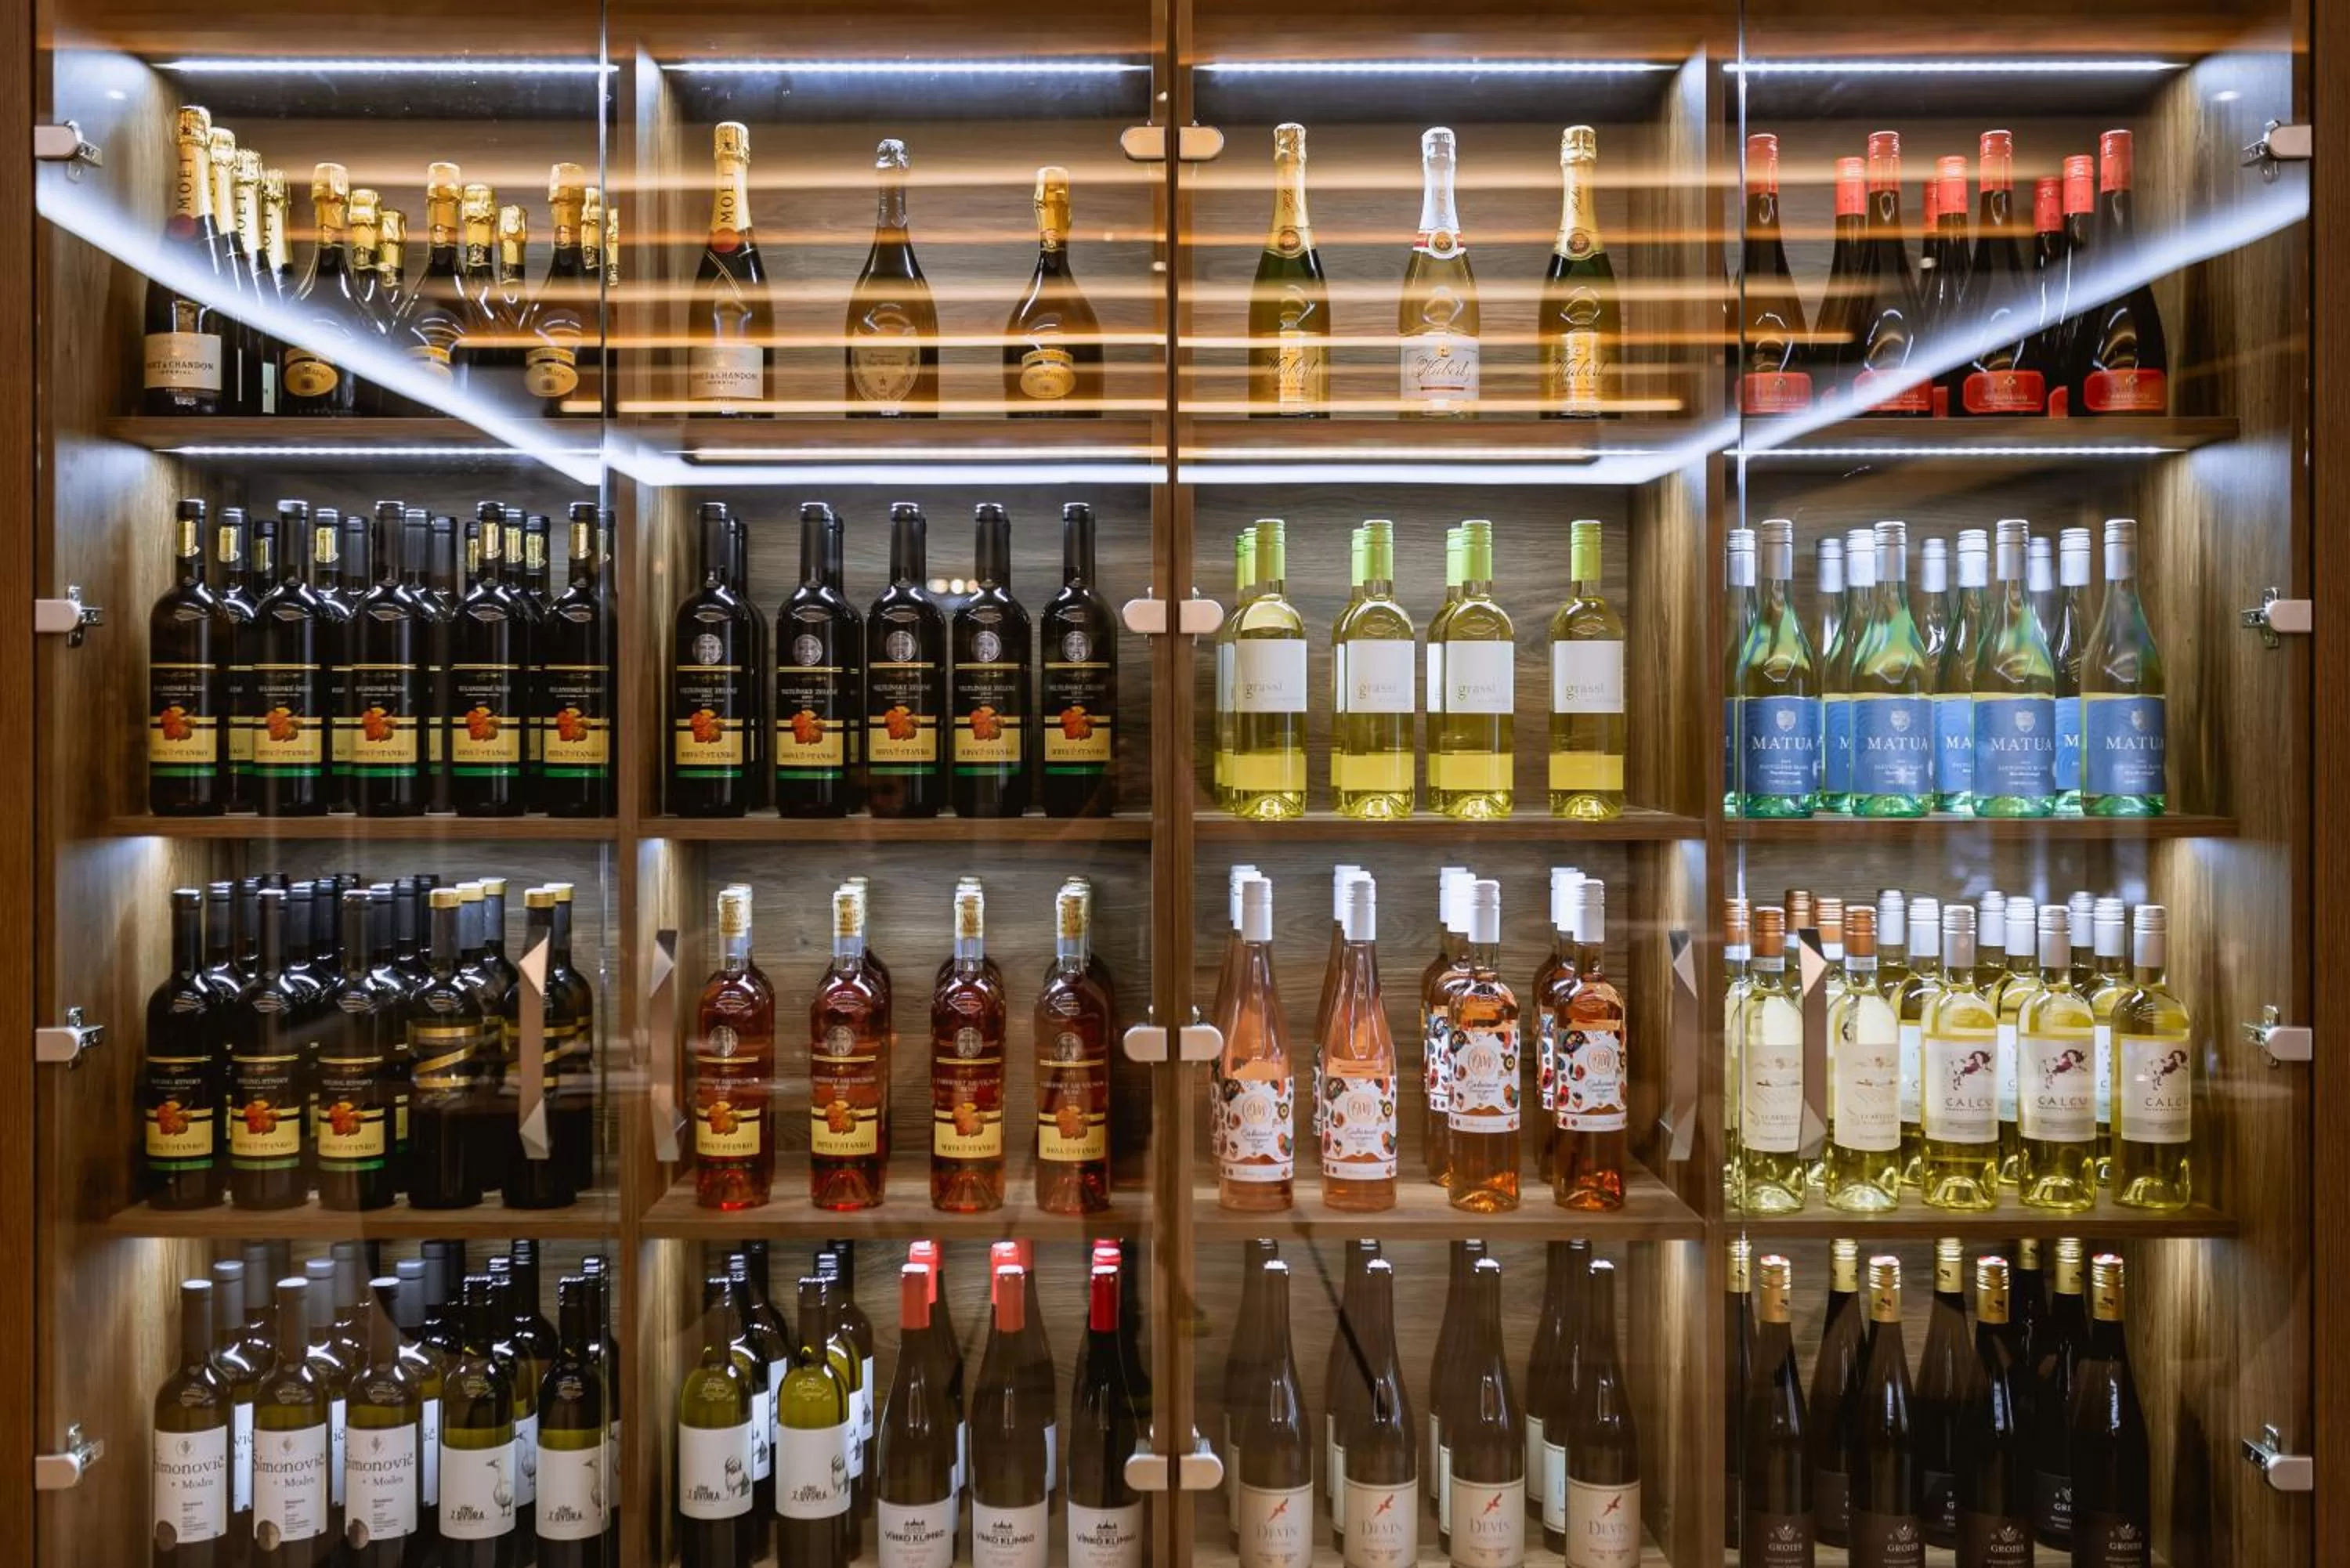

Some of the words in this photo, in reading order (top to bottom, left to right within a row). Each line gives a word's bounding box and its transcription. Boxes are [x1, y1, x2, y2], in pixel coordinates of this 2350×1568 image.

[1415, 355, 1470, 381] Hubert
[1753, 735, 1813, 750] MATUA
[1867, 735, 1928, 750] MATUA
[1991, 737, 2053, 752] MATUA
[2037, 1096, 2088, 1107] CALCU
[154, 1454, 225, 1476] imonovič
